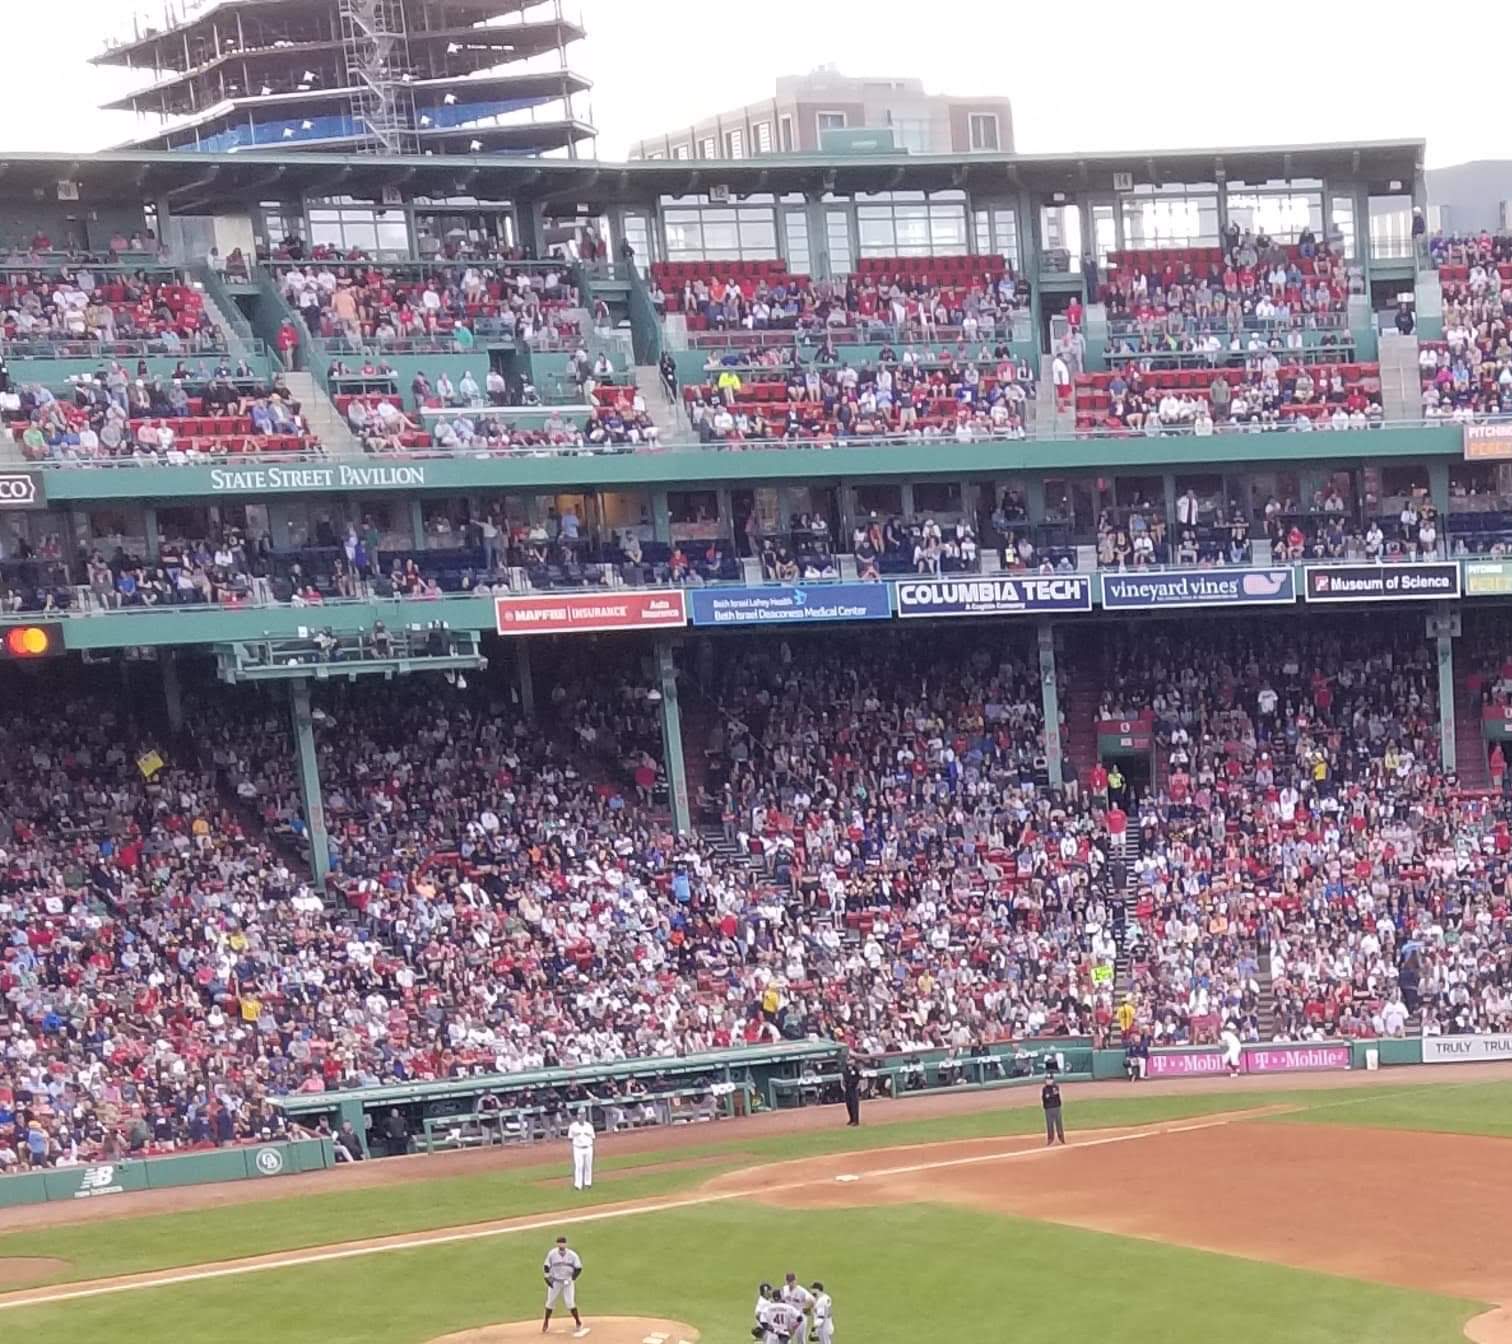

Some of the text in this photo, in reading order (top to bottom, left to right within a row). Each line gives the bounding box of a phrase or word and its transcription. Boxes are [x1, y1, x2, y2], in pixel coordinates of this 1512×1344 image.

[211, 465, 425, 489] STATE STREET PAVILION
[901, 580, 1081, 605] COLUMBIA TECH
[1111, 577, 1238, 601] vineyard vines
[1331, 575, 1449, 591] Museum of Science
[1436, 1041, 1472, 1054] TRULY
